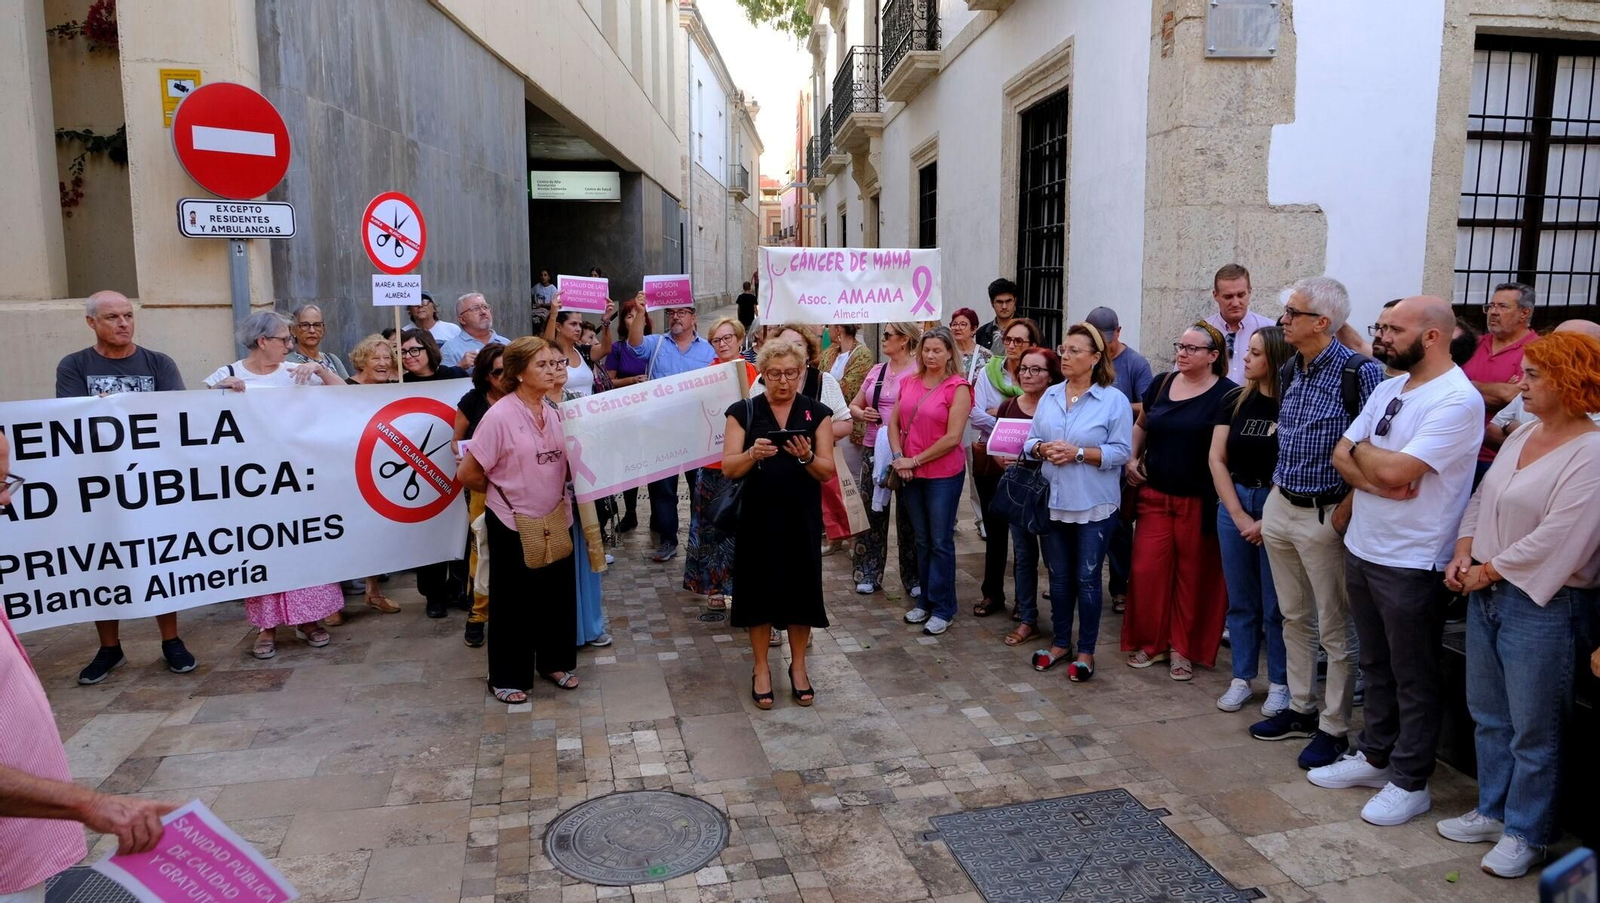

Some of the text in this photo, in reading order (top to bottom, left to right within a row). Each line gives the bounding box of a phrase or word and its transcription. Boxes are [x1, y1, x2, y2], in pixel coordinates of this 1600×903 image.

[210, 215, 270, 224] RESIDENTES
[216, 205, 262, 214] EXCEPTO
[200, 225, 281, 234] Y AMBULANCIAS
[790, 249, 912, 273] CÁNCER DE MAMA
[384, 291, 411, 299] ALMERÍA
[567, 296, 598, 304] PRIORITARIA
[652, 298, 685, 306] AISLADOS
[797, 288, 904, 306] Asoc. AMAMA
[832, 308, 869, 319] Almería
[586, 390, 649, 415] Cáncer
[654, 383, 674, 398] de
[678, 370, 728, 392] mama
[0, 409, 245, 461] ENDE LA
[376, 422, 453, 495] MAREA BLANCA ALMERÍA
[655, 447, 690, 464] AMAMA
[78, 460, 316, 514] PÚBLICA:
[0, 514, 346, 585] PRIVATIZACIONES
[3, 560, 268, 620] Blanca Almería
[166, 844, 241, 900] DE CALIDAD
[172, 817, 277, 903] SANIDAD PÚBLICA
[149, 854, 220, 903] Y GRATUIT
